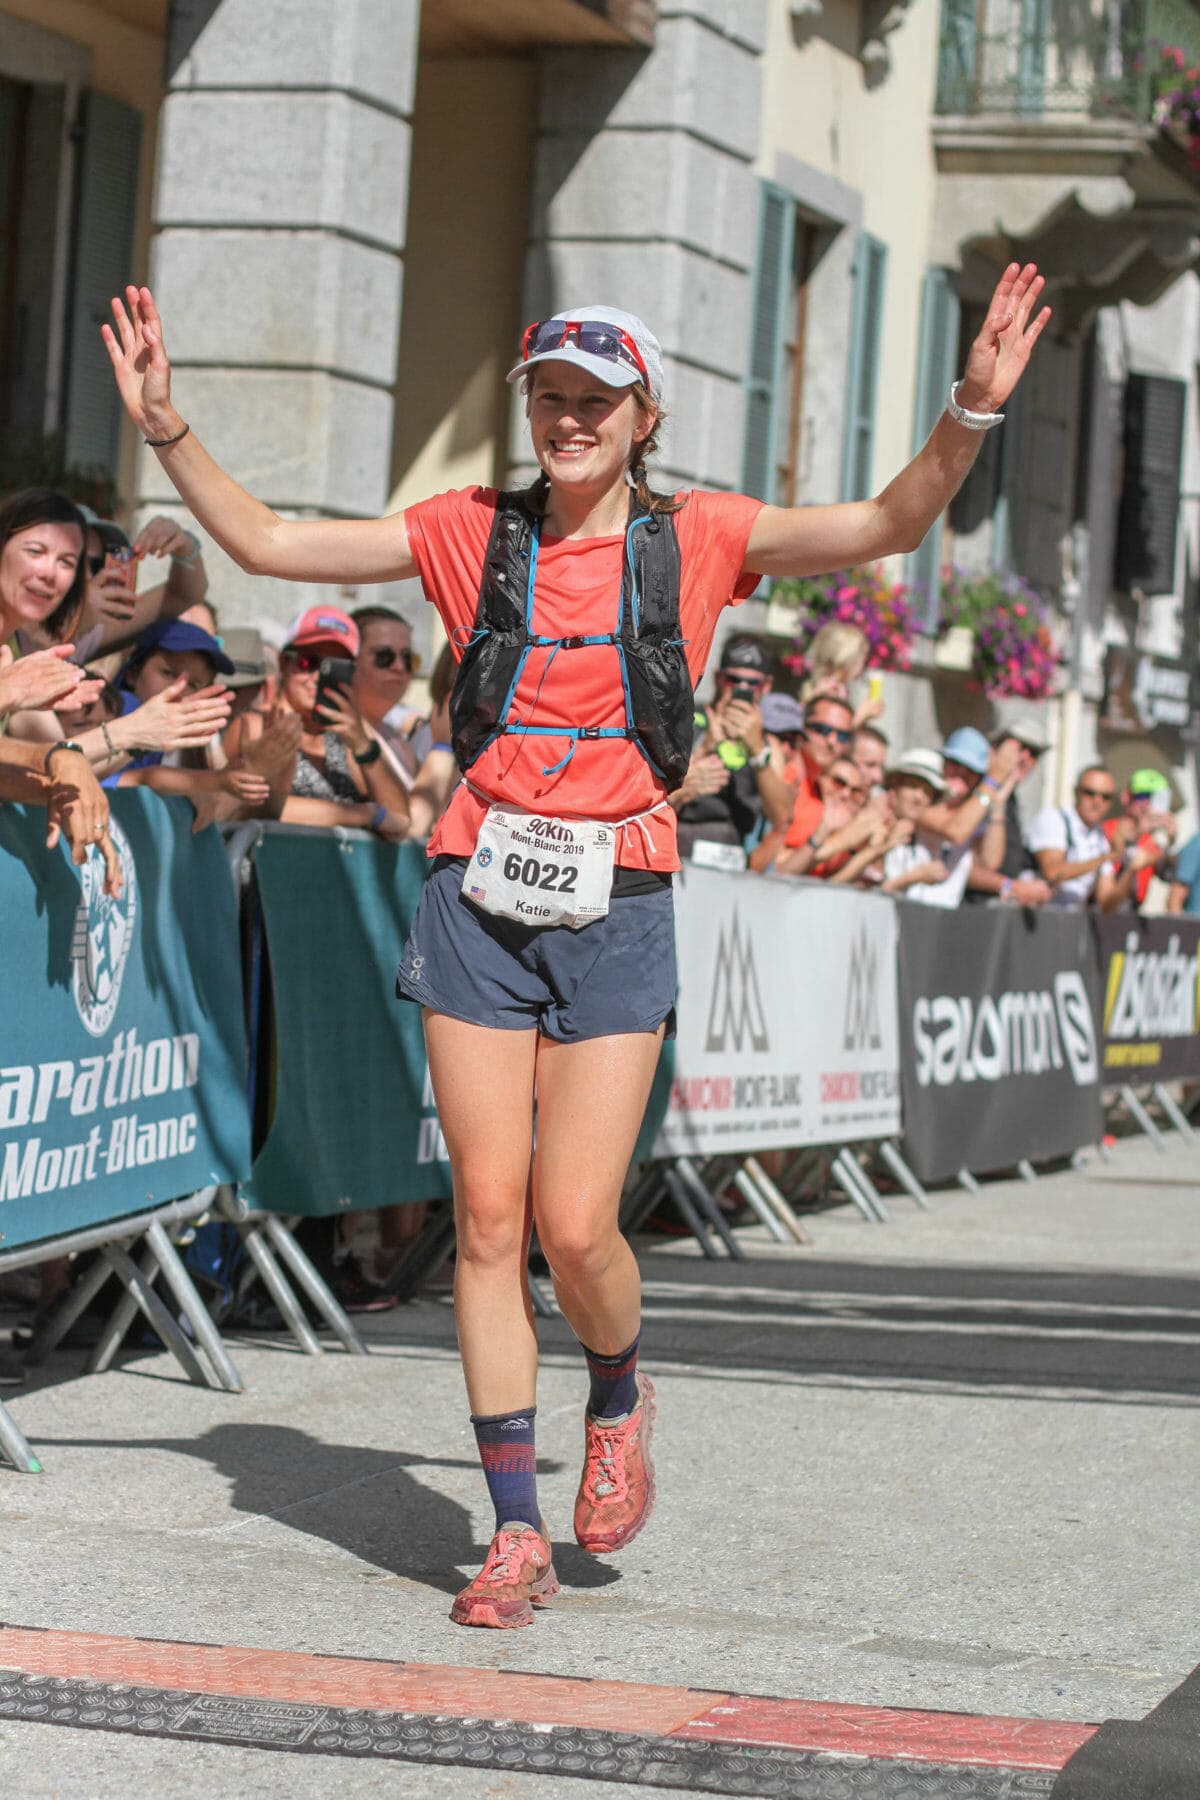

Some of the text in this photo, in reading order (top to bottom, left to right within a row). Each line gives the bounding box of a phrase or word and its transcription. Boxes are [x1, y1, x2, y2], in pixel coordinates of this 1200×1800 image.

[510, 830, 585, 855] Mont-Blanc 2019
[503, 852, 579, 893] 6022
[515, 899, 551, 917] Katie
[0, 1111, 197, 1200] Mont-Blanc
